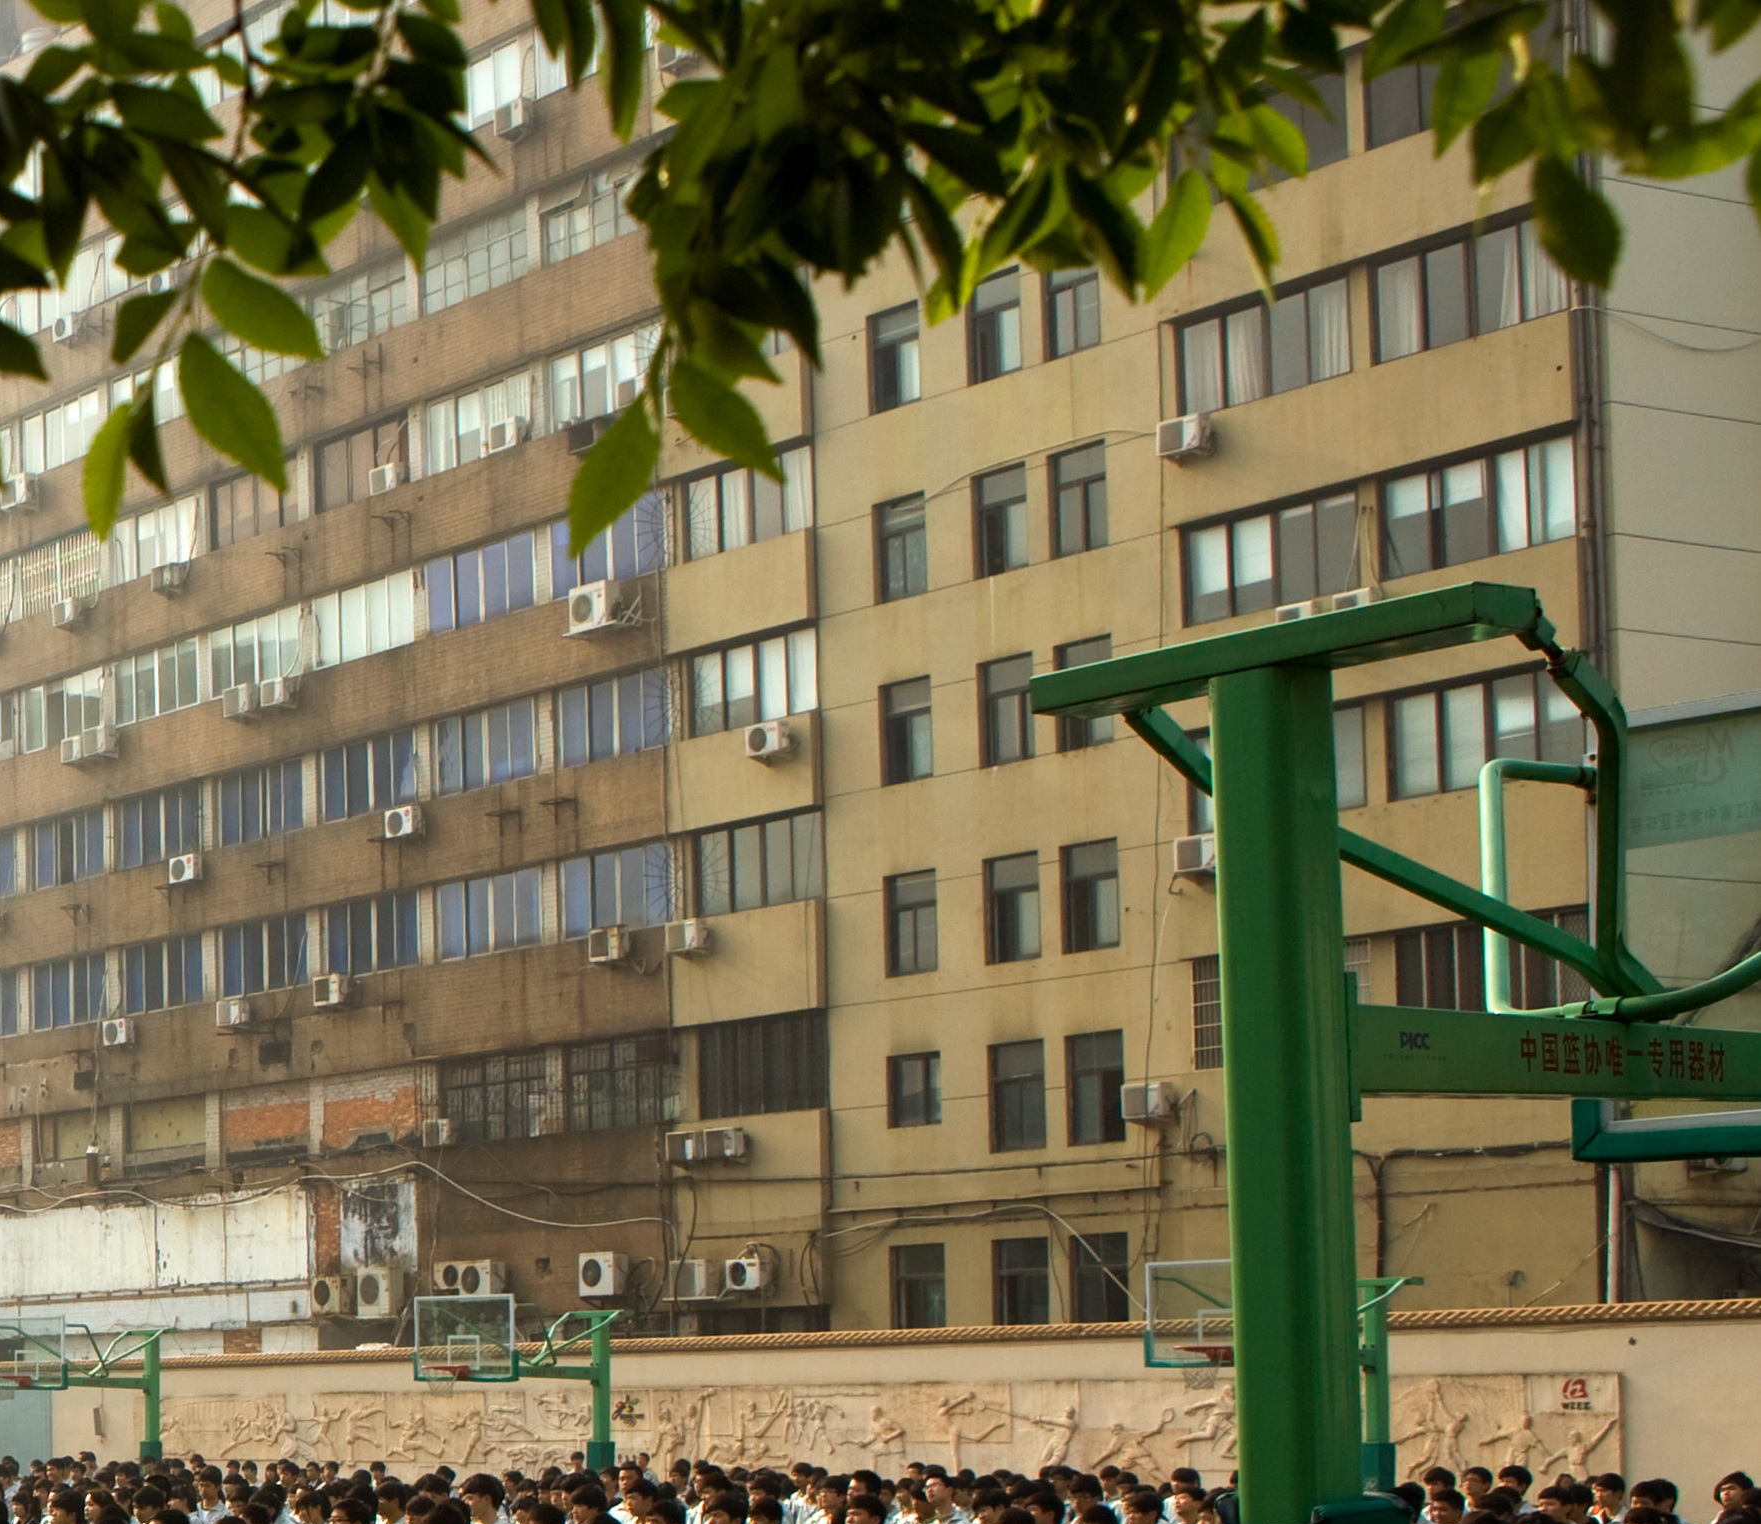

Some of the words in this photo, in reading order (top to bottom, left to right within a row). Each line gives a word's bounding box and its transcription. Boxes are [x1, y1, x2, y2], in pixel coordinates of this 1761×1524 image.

[1399, 1031, 1431, 1050] PICC
[1520, 1029, 1725, 1082] 中国篮协唯一专用器材
